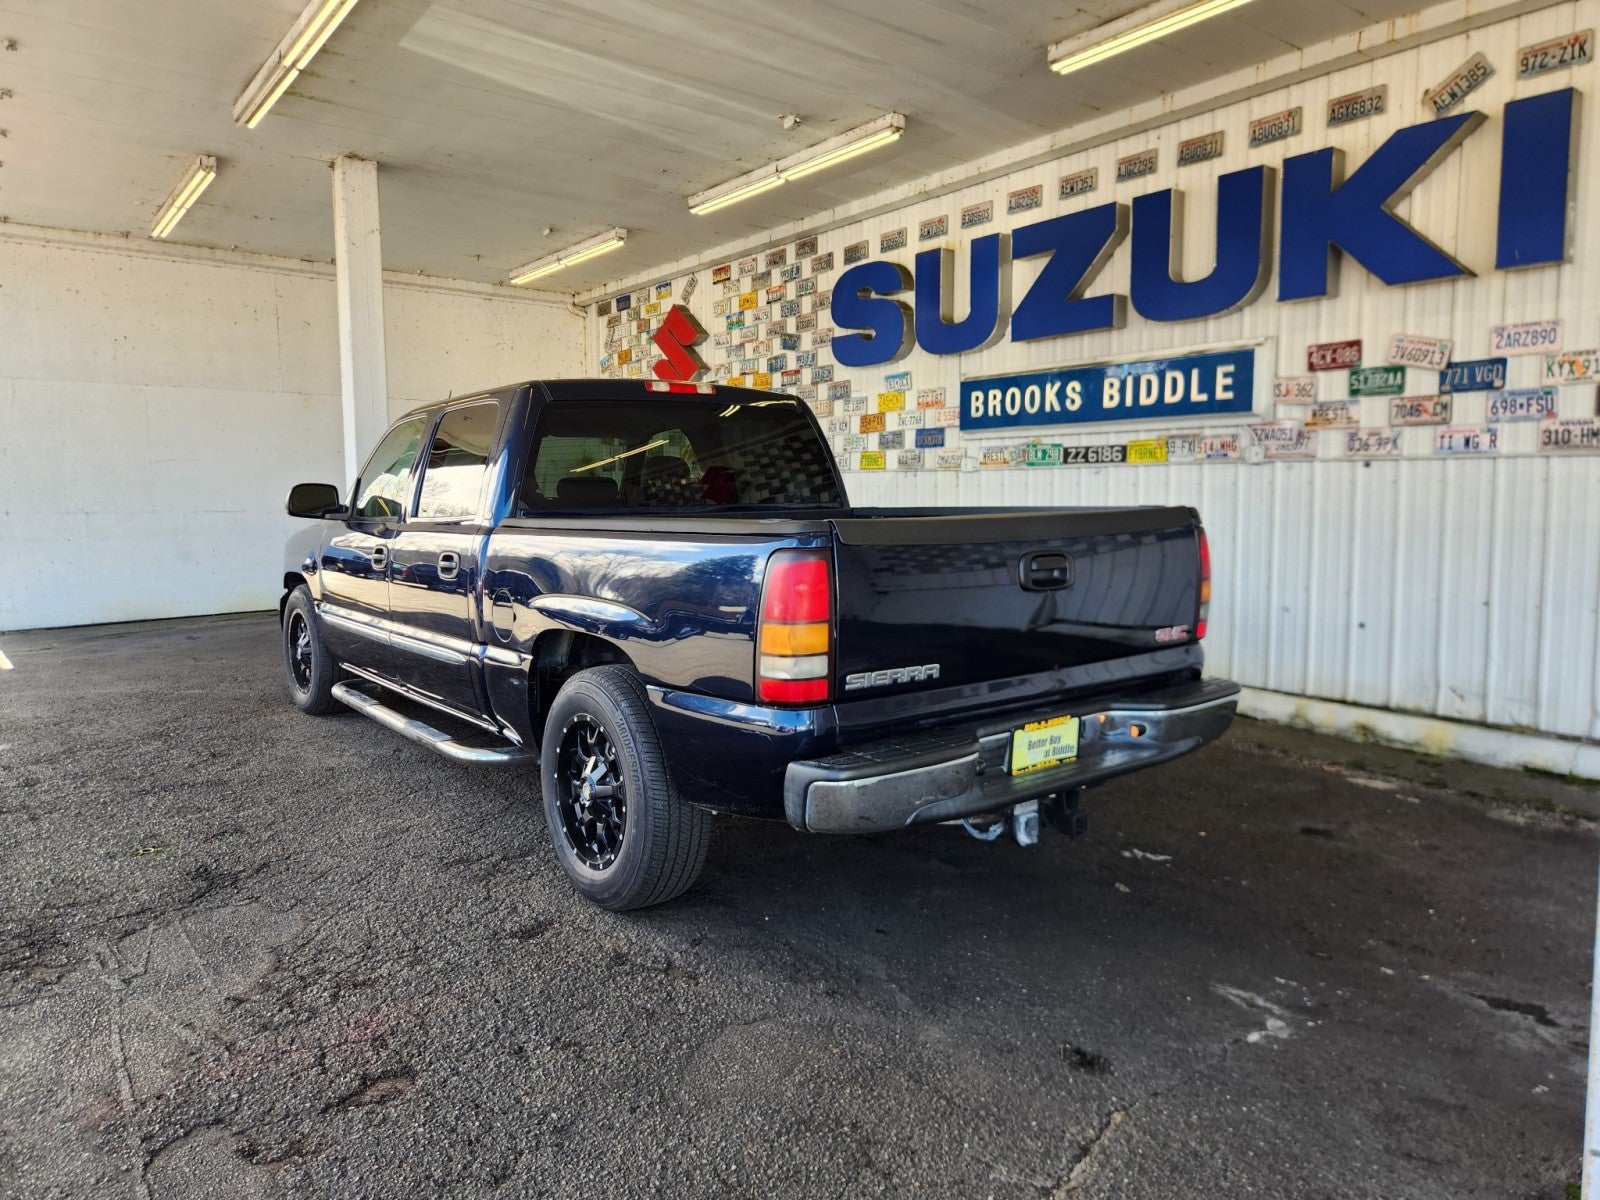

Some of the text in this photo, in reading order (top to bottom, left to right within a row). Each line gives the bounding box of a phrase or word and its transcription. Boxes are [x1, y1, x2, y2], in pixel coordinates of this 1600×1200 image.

[1433, 61, 1488, 113] AEW1385
[1330, 95, 1382, 123] AGY6832
[831, 88, 1581, 367] SUZUKI
[1495, 327, 1556, 349] 2ARZ890
[1546, 359, 1576, 378] KYX
[970, 364, 1236, 418] BROOKS BIDDLE
[1274, 383, 1314, 397] SJ 362
[1489, 433, 1498, 448] R
[1067, 445, 1122, 463] ZZ 6186
[1154, 625, 1188, 643] GMC
[845, 663, 940, 691] SIERRA
[1027, 735, 1062, 751] Better Buy
[1052, 743, 1074, 756] Biddle
